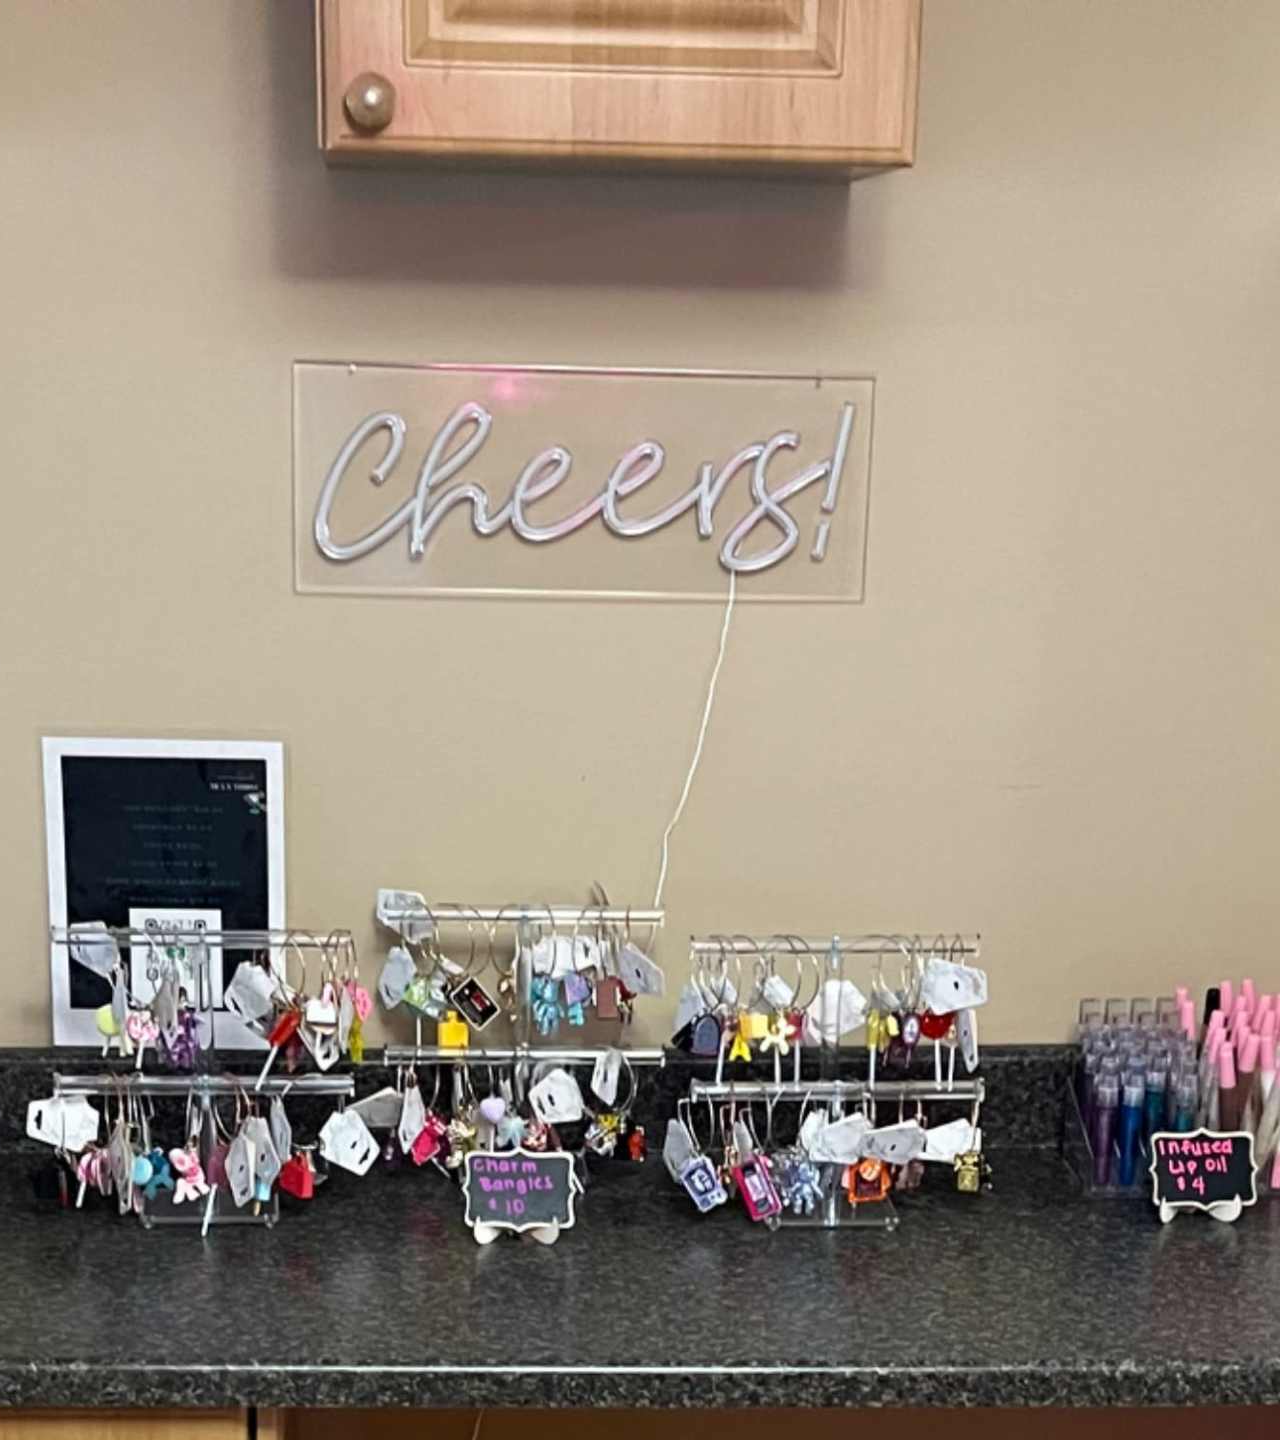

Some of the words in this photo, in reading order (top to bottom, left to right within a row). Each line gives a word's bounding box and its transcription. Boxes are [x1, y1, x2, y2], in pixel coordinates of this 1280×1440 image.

[313, 401, 857, 571] Cheers!
[1159, 1139, 1233, 1156] Infused
[473, 1158, 537, 1173] Charm
[480, 1175, 554, 1195] Bangles
